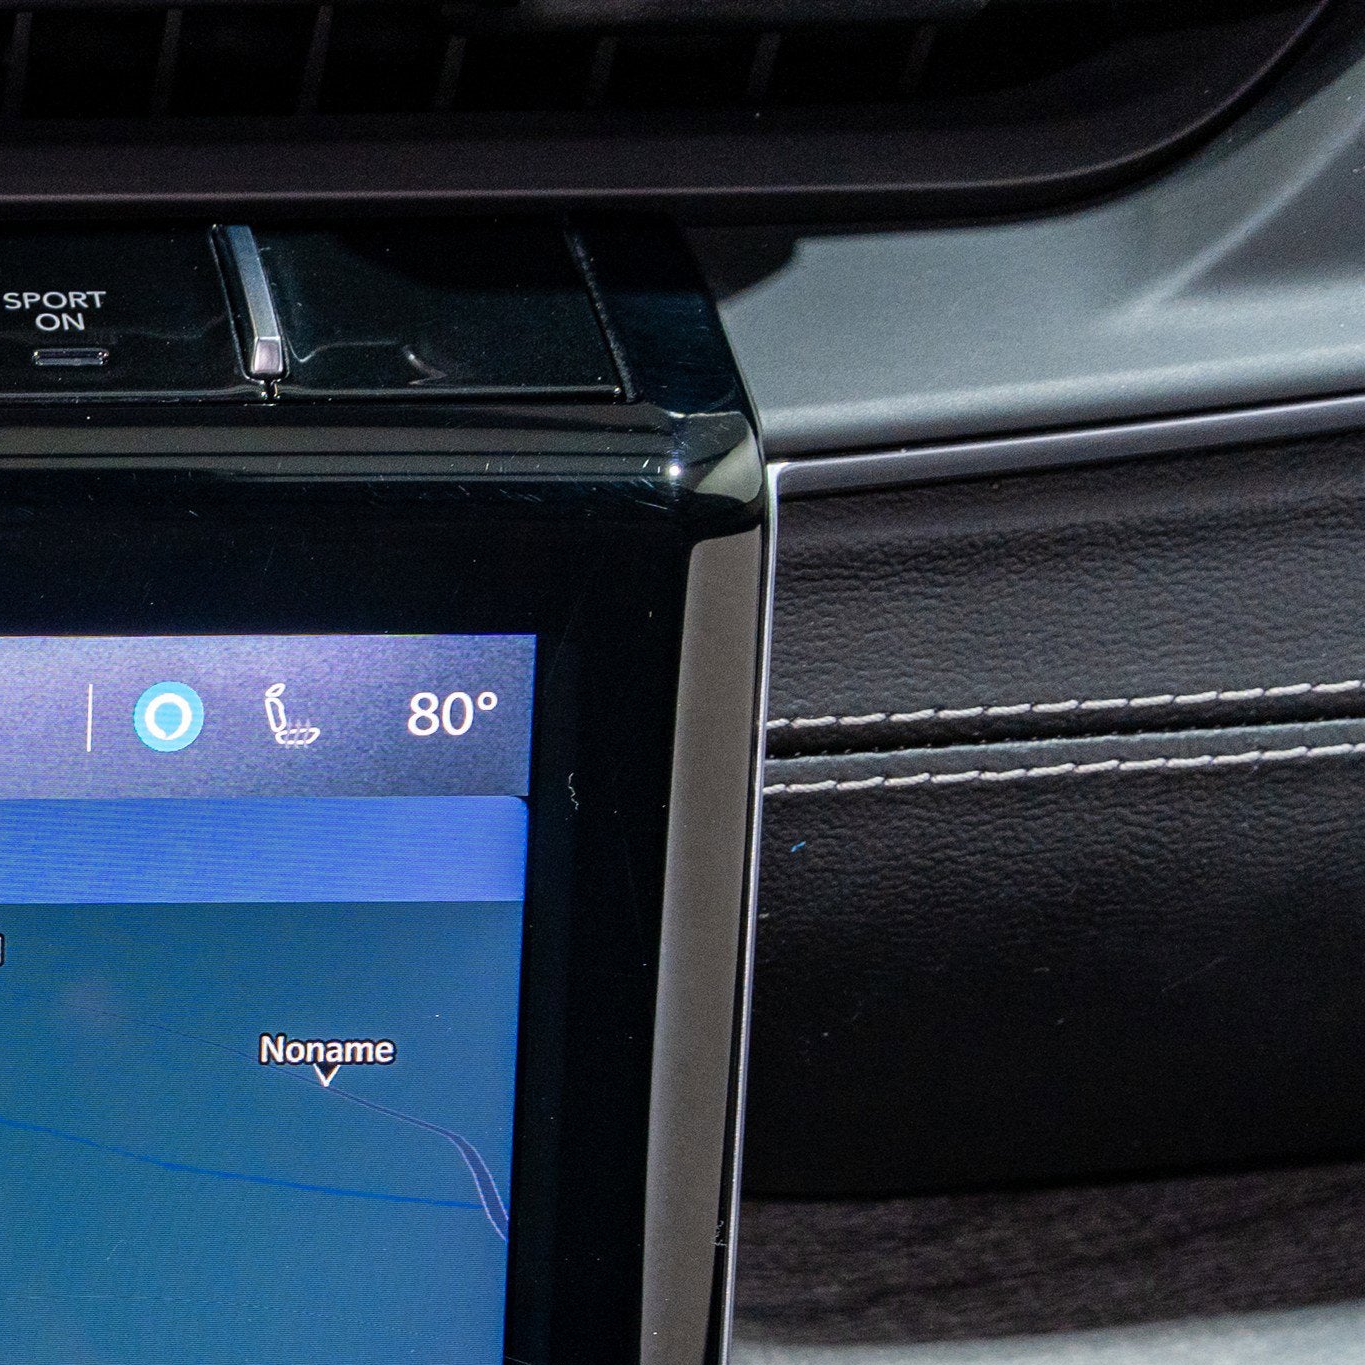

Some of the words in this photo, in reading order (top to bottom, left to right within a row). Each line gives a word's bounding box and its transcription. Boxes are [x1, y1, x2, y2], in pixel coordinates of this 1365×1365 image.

[2, 290, 107, 310] SPORT
[35, 312, 85, 332] ON
[261, 1035, 394, 1064] Noname
